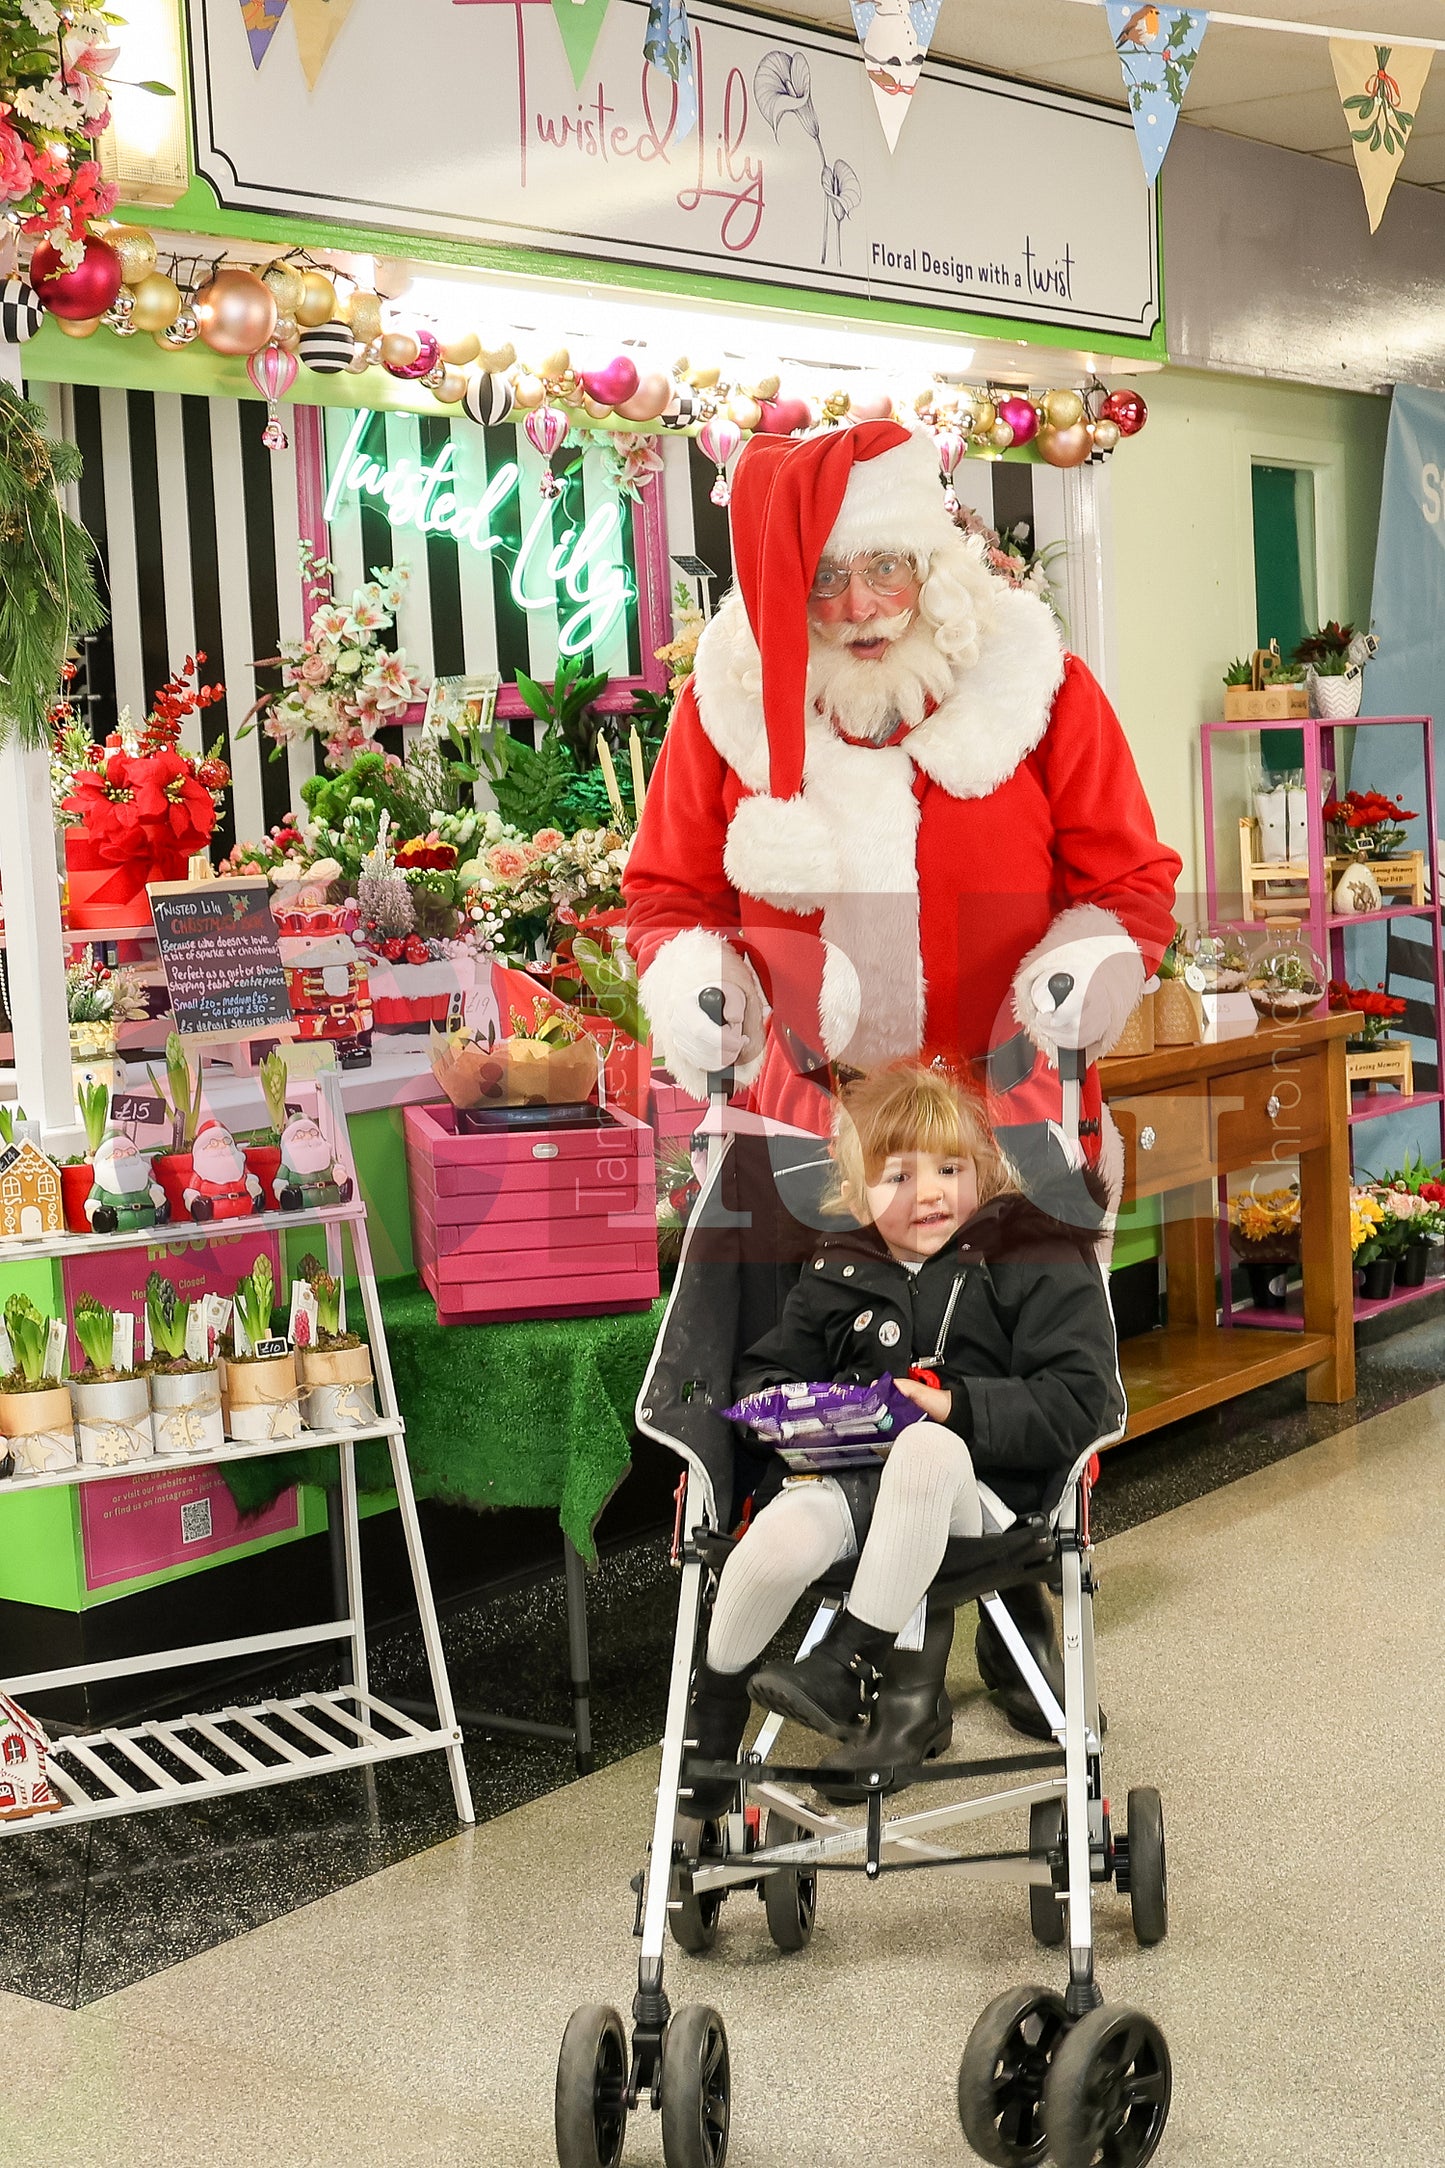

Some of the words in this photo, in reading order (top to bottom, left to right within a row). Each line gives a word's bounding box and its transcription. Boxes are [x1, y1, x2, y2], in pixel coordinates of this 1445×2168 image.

[676, 25, 765, 251] Lily
[871, 243, 917, 271] Floral
[922, 251, 974, 284] Design
[978, 262, 1010, 287] with
[1014, 272, 1022, 288] a
[1022, 235, 1075, 302] twist
[323, 407, 520, 552] Twisted
[511, 494, 636, 657] Lily
[161, 939, 197, 954] Because
[197, 937, 215, 949] who
[250, 935, 269, 945] love
[163, 953, 171, 962] a
[170, 950, 185, 961] bit
[185, 948, 195, 961] of
[226, 948, 237, 957] at
[171, 965, 204, 980] Perfect
[206, 969, 217, 979] as
[218, 969, 226, 979] a
[227, 963, 244, 982] gift
[245, 966, 254, 976] or
[207, 979, 231, 991] table
[173, 997, 198, 1012] Small
[246, 1004, 266, 1015] £30
[180, 1019, 193, 1034] £5
[196, 1018, 229, 1032] deposit
[114, 1098, 150, 1122] £15
[178, 1274, 206, 1290] Closed
[260, 1342, 281, 1354] £10
[112, 1495, 121, 1504] or
[122, 1489, 141, 1502] visit
[142, 1485, 155, 1497] our
[156, 1476, 187, 1491] website
[188, 1474, 196, 1483] at
[103, 1511, 112, 1520] or
[114, 1503, 131, 1517] find
[132, 1503, 142, 1511] us
[143, 1499, 153, 1509] on
